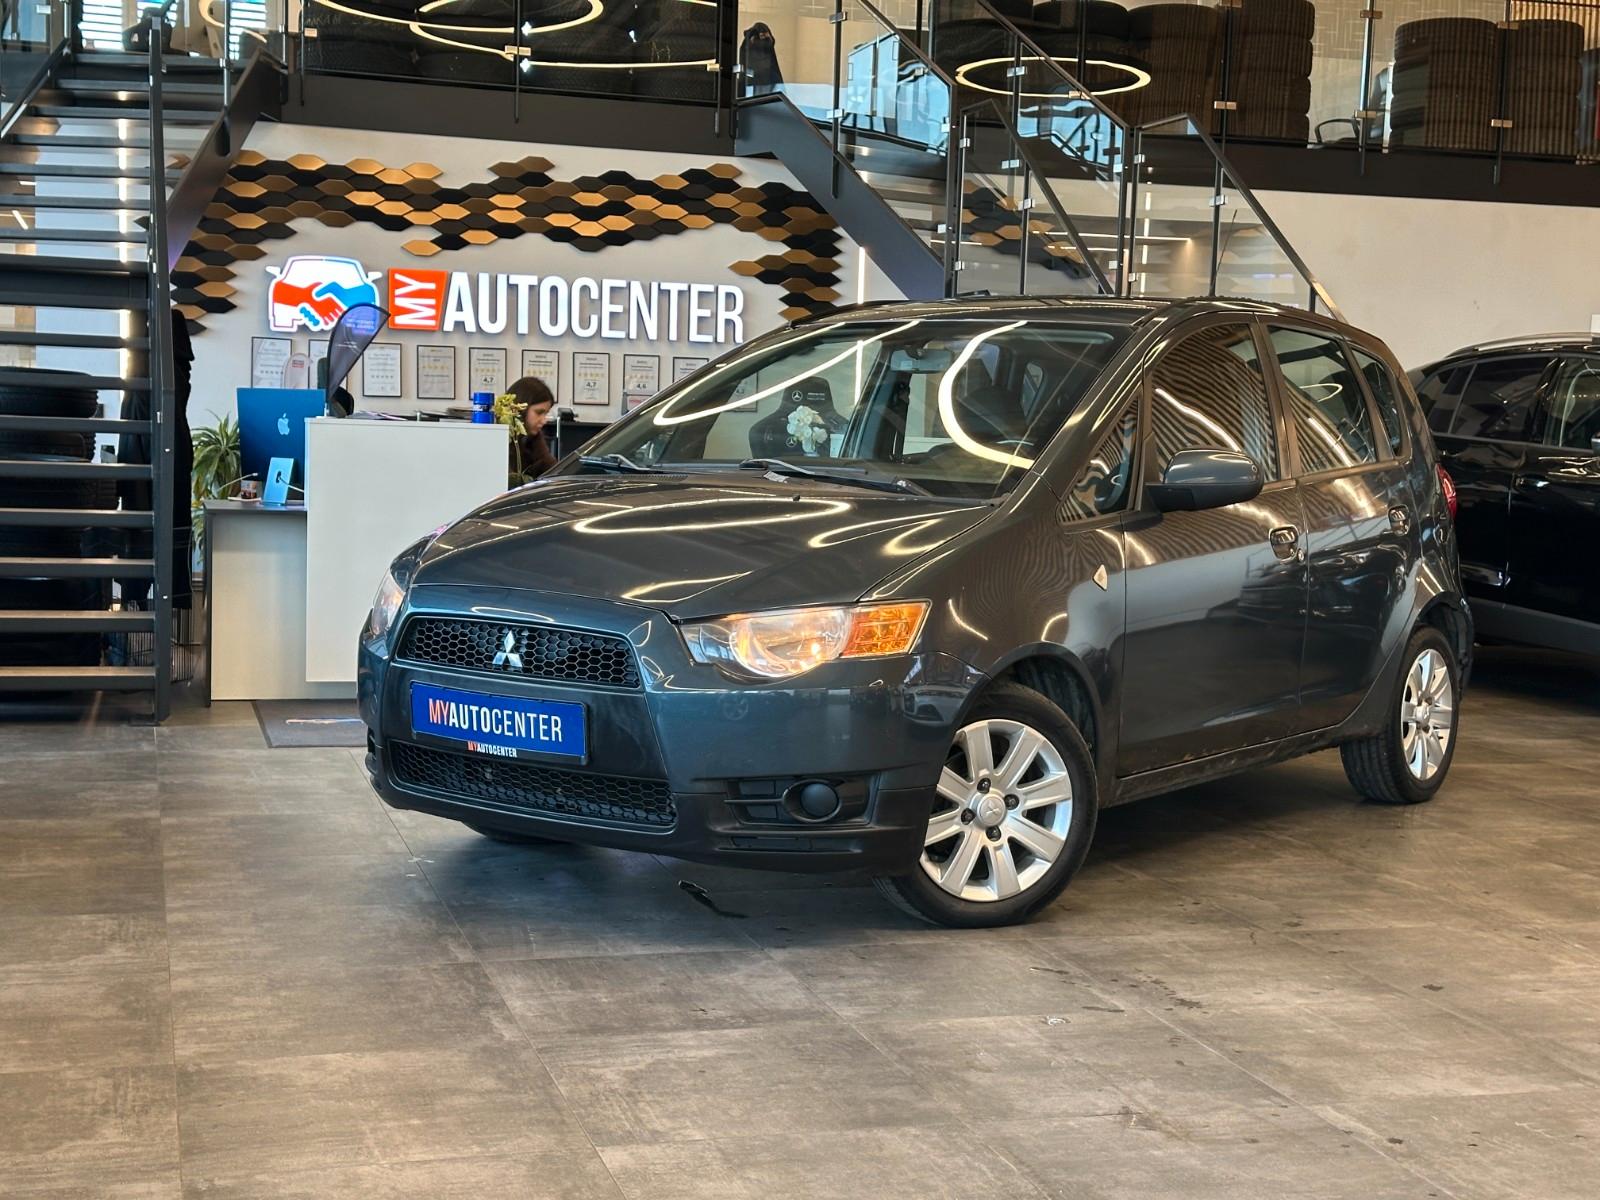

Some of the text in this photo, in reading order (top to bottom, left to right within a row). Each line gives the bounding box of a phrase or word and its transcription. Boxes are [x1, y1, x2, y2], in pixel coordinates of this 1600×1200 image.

[394, 271, 744, 344] MY AUTOCENTER
[428, 698, 562, 742] MYAUTOCENTER
